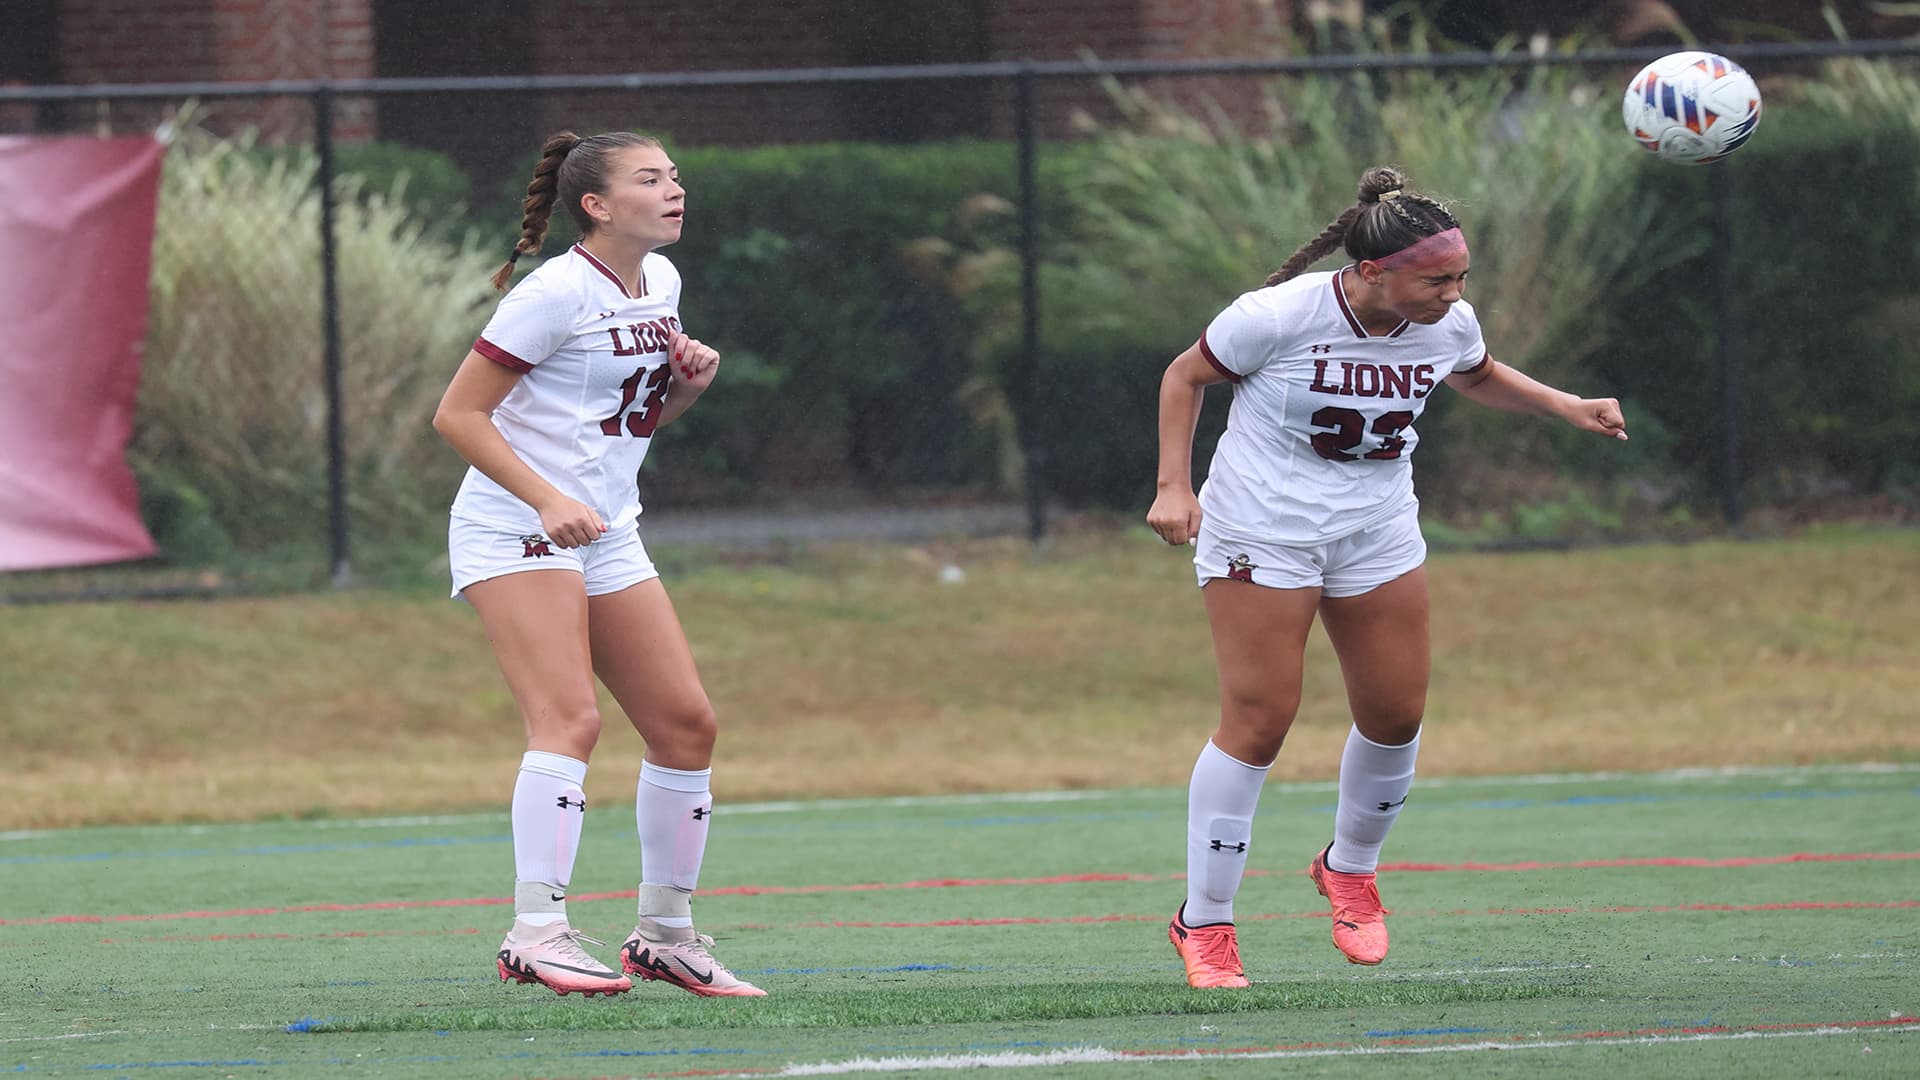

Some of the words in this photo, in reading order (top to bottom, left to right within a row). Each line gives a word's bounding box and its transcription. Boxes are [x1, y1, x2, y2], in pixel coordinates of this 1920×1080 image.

[600, 363, 672, 438] 13
[1309, 359, 1435, 399] LIONS
[1310, 406, 1414, 462] 23
